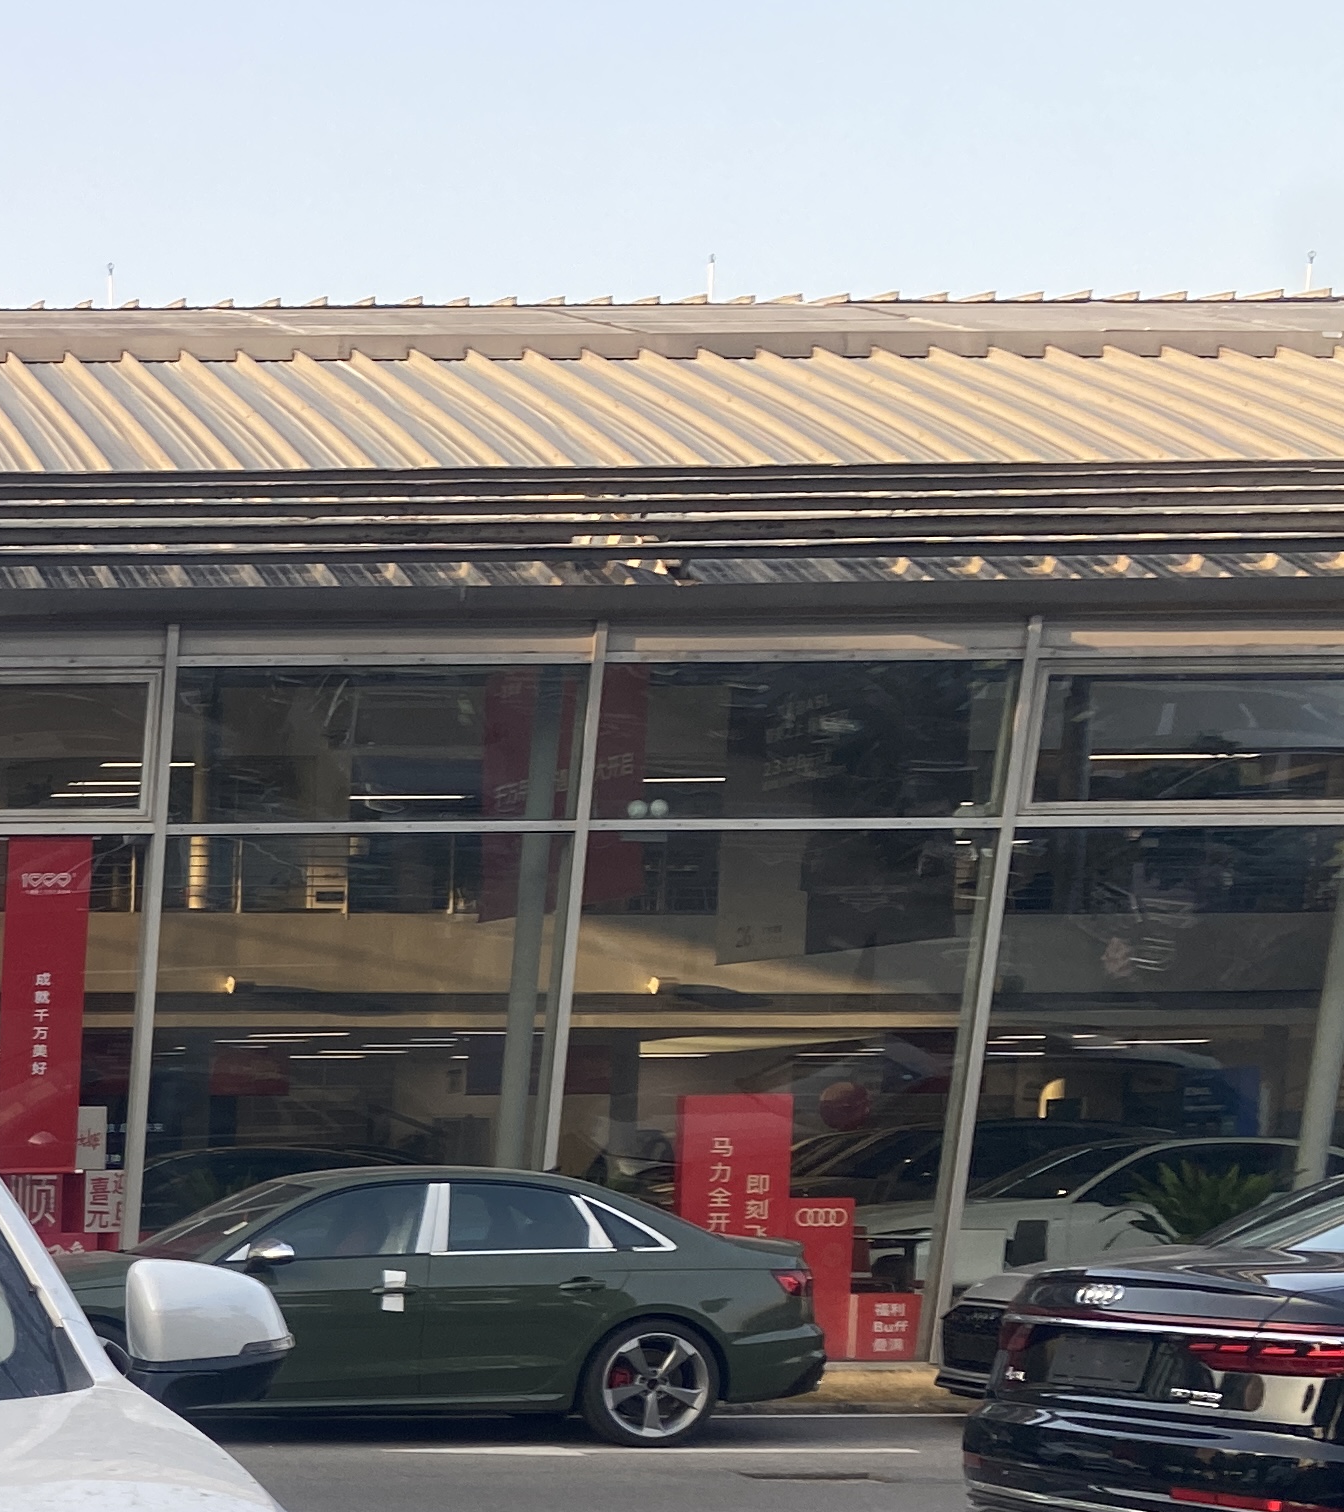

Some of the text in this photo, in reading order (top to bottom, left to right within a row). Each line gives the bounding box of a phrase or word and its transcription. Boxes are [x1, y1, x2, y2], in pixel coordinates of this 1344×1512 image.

[31, 972, 52, 1076] 成就千万美好
[706, 1137, 734, 1232] 马力全开
[872, 1321, 909, 1333] Buff
